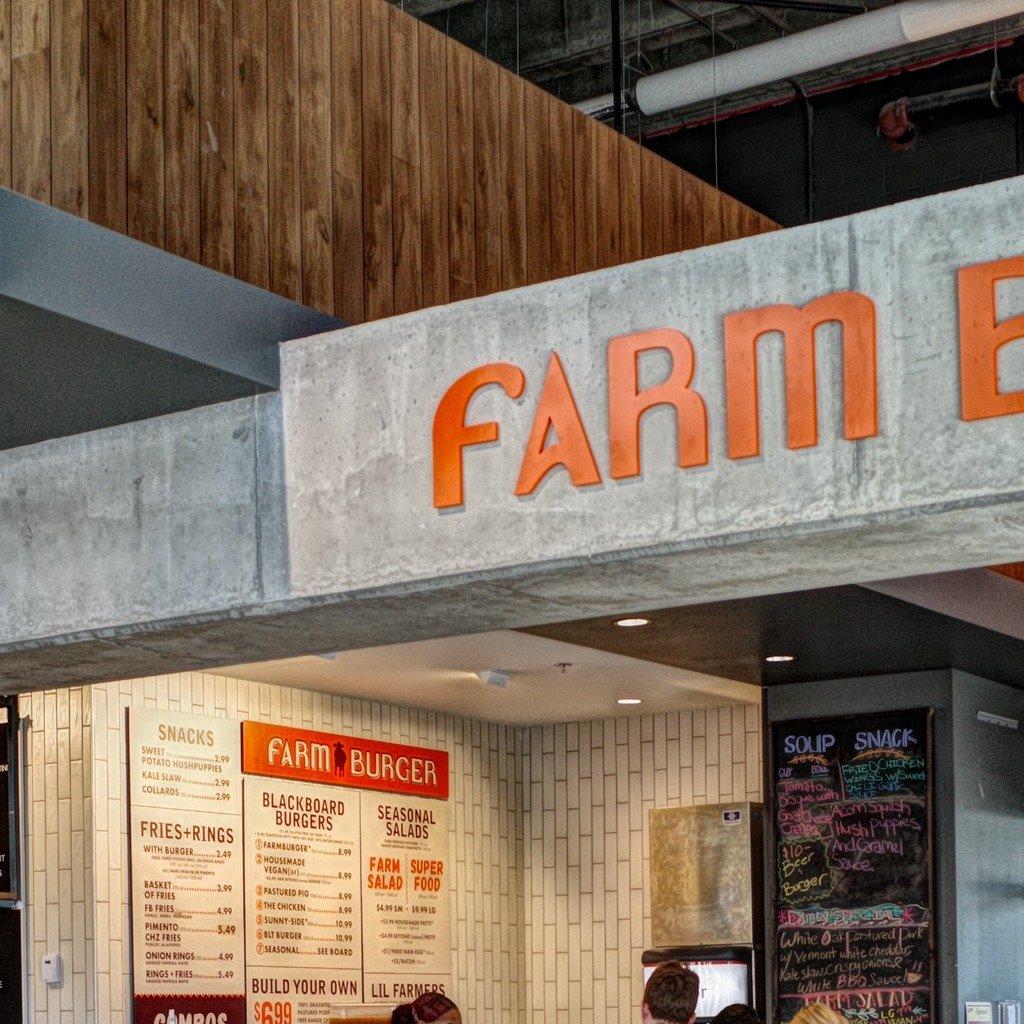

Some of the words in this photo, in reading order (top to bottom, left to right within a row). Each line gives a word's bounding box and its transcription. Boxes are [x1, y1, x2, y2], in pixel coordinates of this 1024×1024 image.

[432, 290, 878, 508] FARM
[159, 724, 214, 747] SNACKS
[784, 734, 836, 753] SOUP
[854, 728, 918, 750] SNACK
[142, 746, 165, 756] SWEET
[215, 754, 230, 763] 2.99
[267, 736, 331, 773] FARM
[350, 749, 438, 787] BURGER
[142, 757, 171, 767] POTATO
[173, 761, 222, 773] HUSHPUPPIES
[142, 771, 160, 780] KALE
[162, 773, 182, 782] SLAW
[215, 779, 230, 787] 2.99
[142, 785, 180, 796] COLLARDS
[263, 791, 345, 816] BLACKBOARD
[276, 810, 333, 831] BURGERS
[378, 805, 436, 825] SEASONAL
[140, 820, 234, 844] FRIES+RINGS
[386, 821, 429, 839] SALADS
[144, 845, 163, 854] WITH
[165, 847, 194, 856] BURGER
[216, 850, 232, 858] 2.49
[264, 856, 306, 866] HOUSEMADE
[370, 857, 401, 873] FARM
[410, 859, 444, 875] SUPER
[782, 852, 814, 877] Beer
[338, 872, 352, 880] 8.99
[367, 874, 403, 890] SALAD
[414, 876, 441, 892] FOOD
[144, 880, 171, 889] BASKET
[217, 884, 232, 893] 3.99
[264, 887, 296, 896] PASTURED
[298, 889, 309, 898] PIG
[782, 873, 827, 896] Burger
[144, 891, 154, 899] OF
[157, 891, 175, 900] FRIES
[145, 904, 153, 912] FB
[156, 905, 174, 913] FRIES
[217, 907, 232, 915] 4.99
[264, 901, 275, 910] THE
[277, 902, 306, 911] CHICKEN
[376, 904, 393, 912] $4.99
[429, 906, 436, 914] LG
[145, 923, 179, 931] PIMENTO
[218, 925, 236, 934] 5.49
[336, 920, 353, 928] 10.99
[145, 933, 160, 941] CHZ
[162, 934, 181, 942] FRIES
[276, 931, 302, 940] BURGER
[146, 952, 171, 960] ONION
[173, 952, 195, 960] RINGS
[219, 953, 233, 961] 4.99
[265, 945, 299, 954] SEASONAL
[330, 948, 353, 956] BOARD
[146, 970, 169, 978] RINGS
[175, 970, 193, 978] FRIES
[218, 971, 234, 979] 5.49
[836, 974, 867, 988] BBQ
[252, 978, 290, 994] BUILD
[293, 979, 326, 995] YOUR
[330, 980, 357, 995] OWN
[372, 983, 389, 998] LIL
